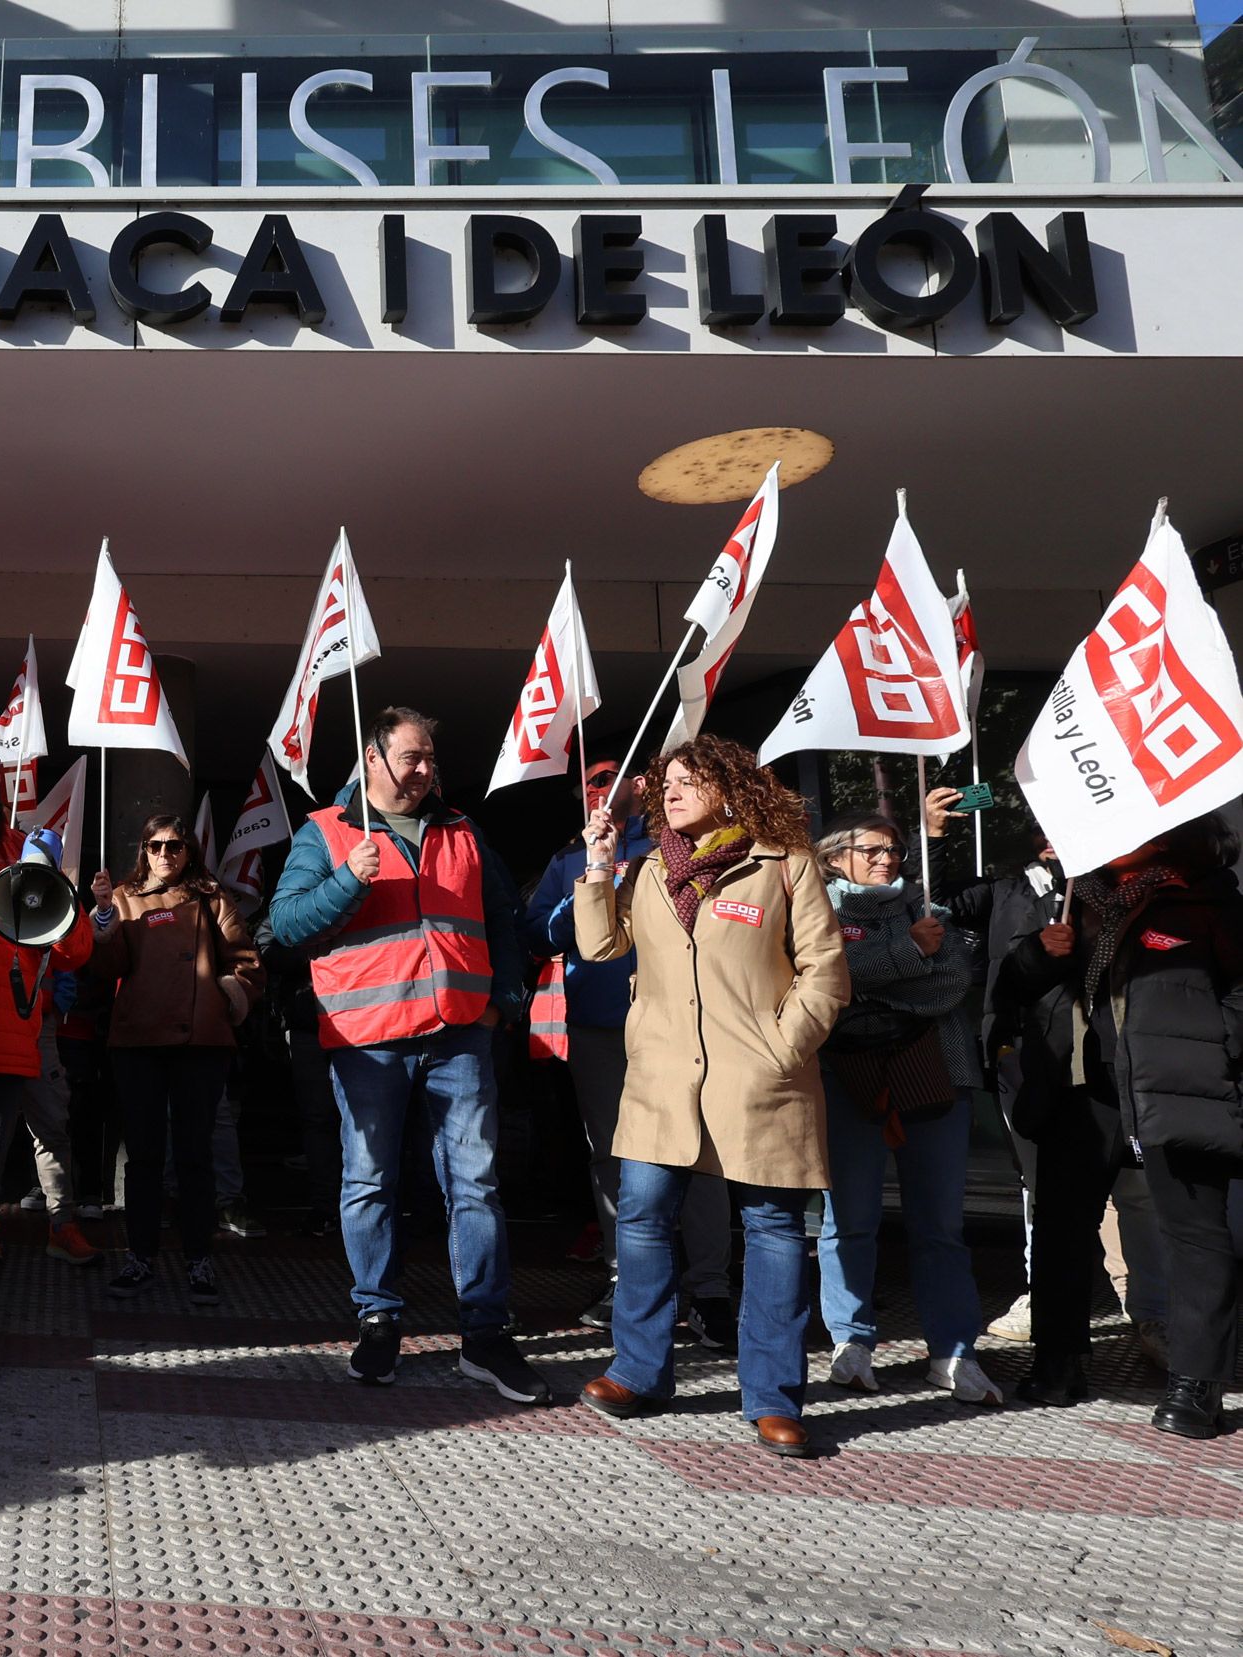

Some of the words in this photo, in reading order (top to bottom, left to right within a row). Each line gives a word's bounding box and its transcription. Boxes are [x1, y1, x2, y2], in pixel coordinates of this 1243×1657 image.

[711, 37, 1243, 186] LEÓN
[379, 213, 409, 325] I
[464, 213, 648, 326] DE
[693, 184, 1099, 334] LEÓN
[1051, 674, 1077, 725] stilla
[1054, 724, 1084, 741] y
[1069, 741, 1117, 805] León
[147, 911, 175, 924] CCOO
[716, 901, 760, 917] CCOO
